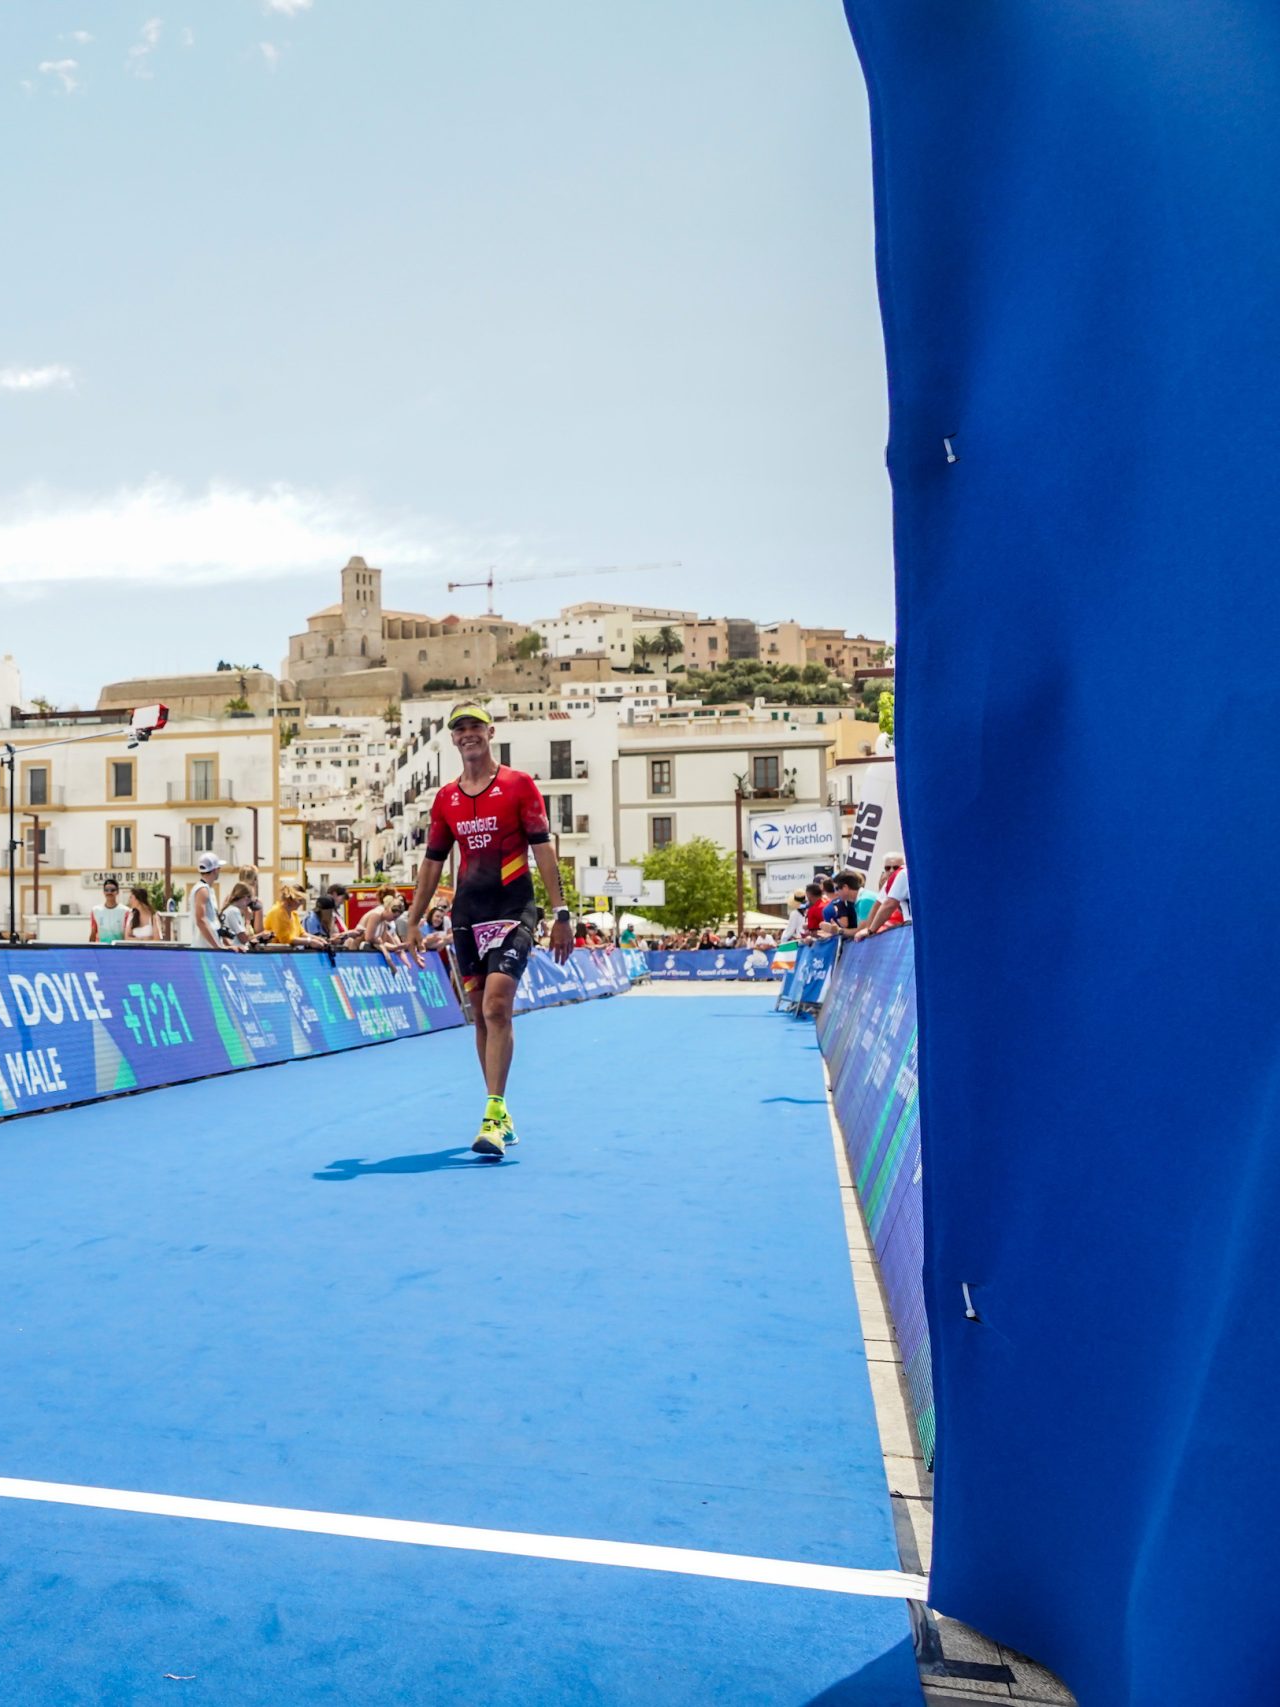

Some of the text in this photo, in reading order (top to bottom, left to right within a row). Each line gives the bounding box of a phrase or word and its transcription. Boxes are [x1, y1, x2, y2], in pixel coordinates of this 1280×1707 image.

[784, 822, 818, 835] World
[467, 833, 492, 850] ESP
[784, 832, 833, 847] Triathlon
[93, 872, 159, 881] CASINO DE IBIZA
[9, 970, 112, 1027] DOYLE
[122, 982, 195, 1048] +7:21
[5, 1047, 67, 1098] MALE
